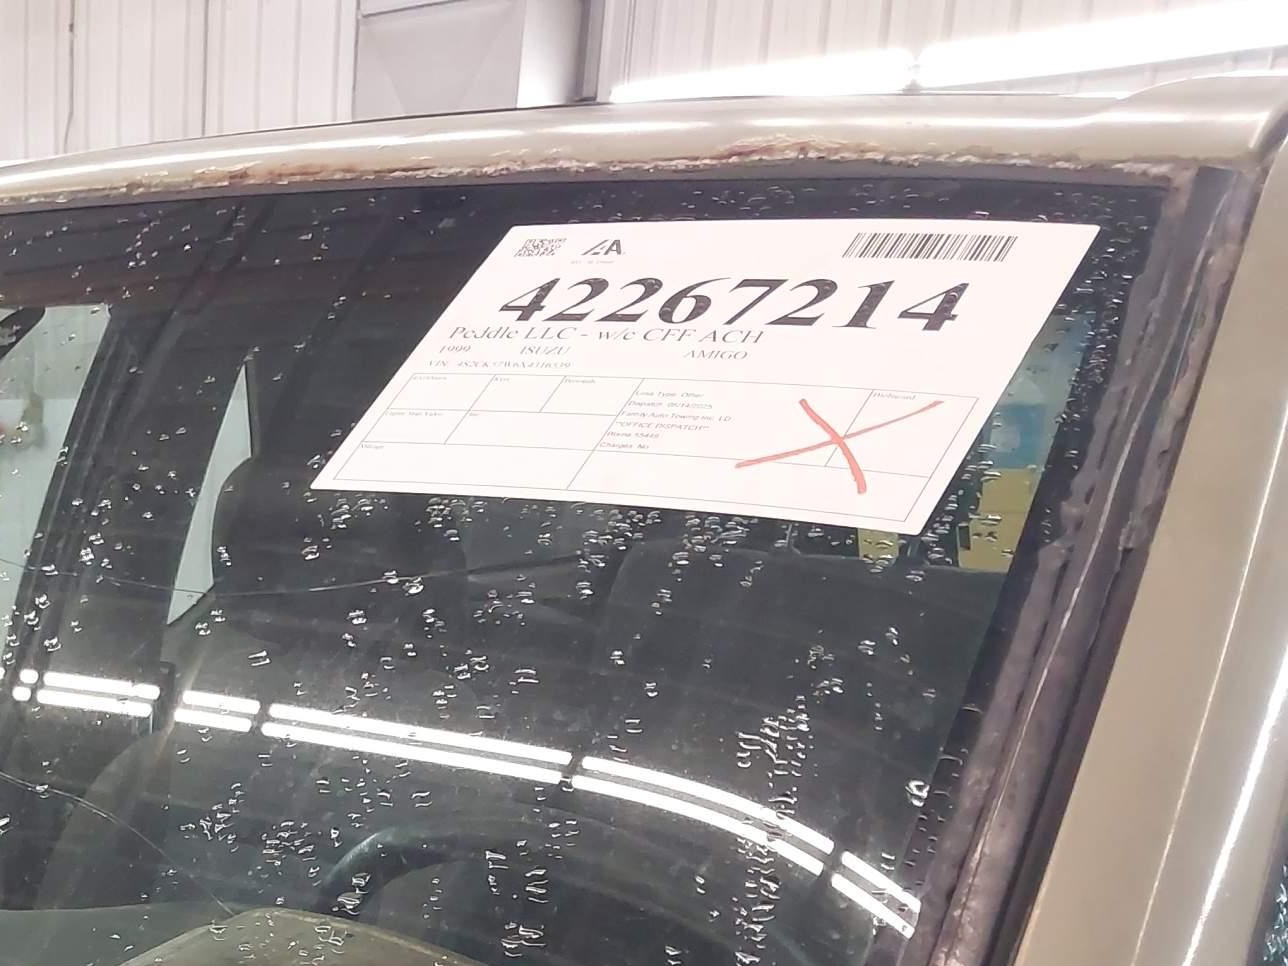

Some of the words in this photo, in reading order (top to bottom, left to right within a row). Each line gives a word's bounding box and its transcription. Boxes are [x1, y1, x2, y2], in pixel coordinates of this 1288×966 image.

[498, 277, 971, 333] 42267214
[449, 326, 519, 339] Peddle
[524, 326, 577, 340] LLC
[698, 329, 765, 344] ACH
[519, 345, 572, 355] ISUZU
[682, 349, 749, 360] AMIGO
